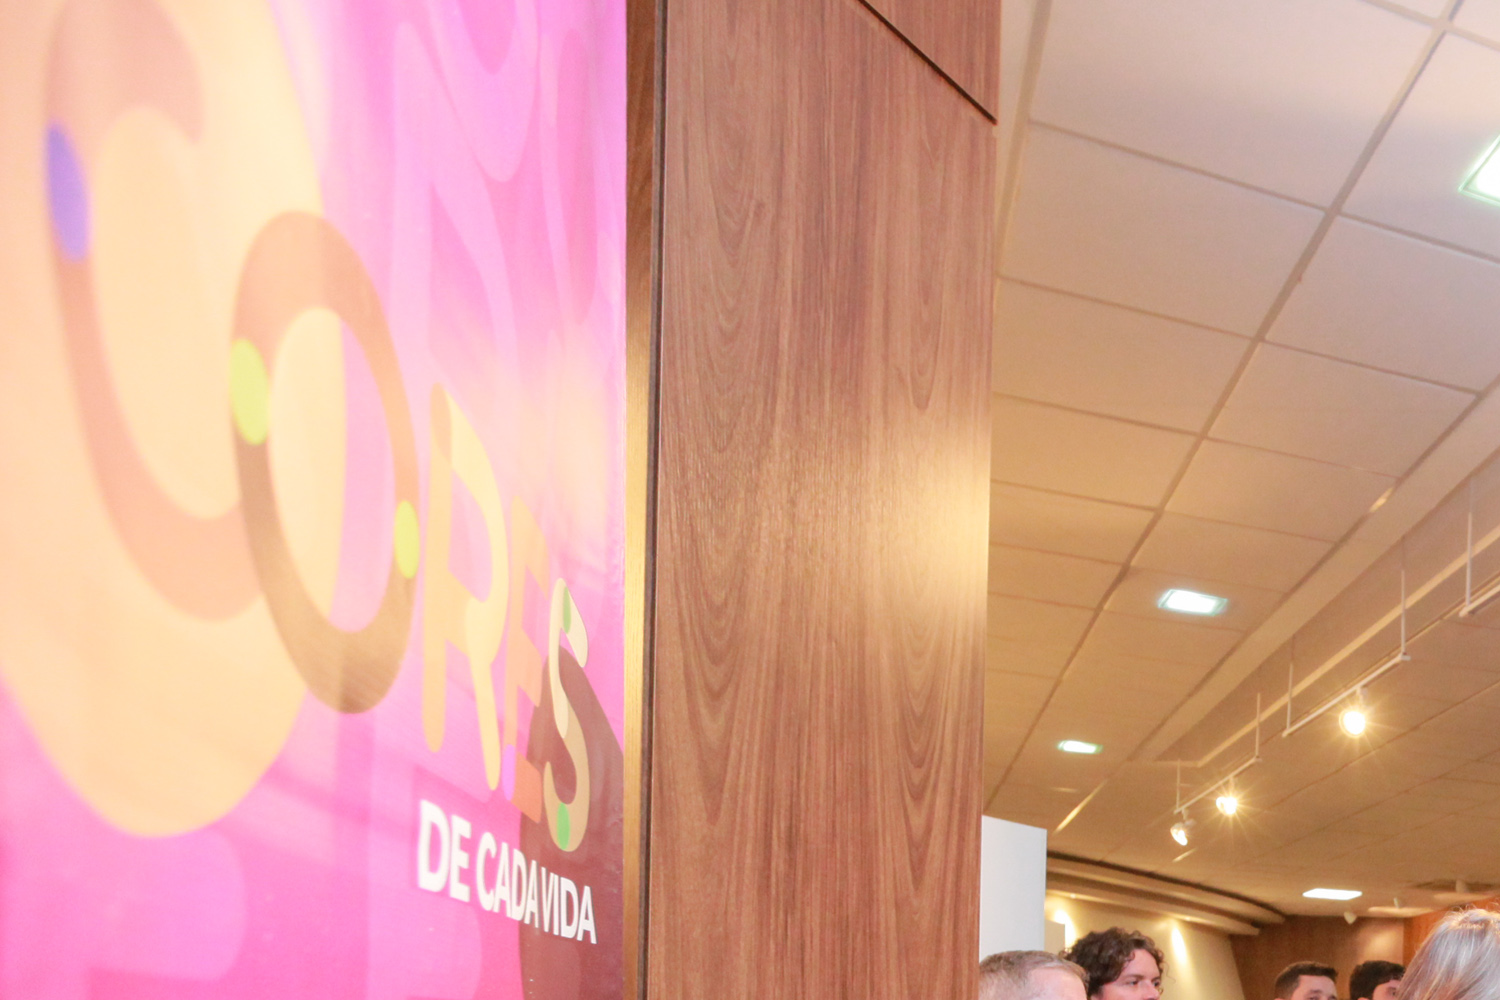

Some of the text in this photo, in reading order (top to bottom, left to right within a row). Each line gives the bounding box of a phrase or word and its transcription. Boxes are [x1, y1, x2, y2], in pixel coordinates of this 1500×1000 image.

[42, 0, 590, 853] CORES
[417, 799, 598, 945] DE CADA VIDA
